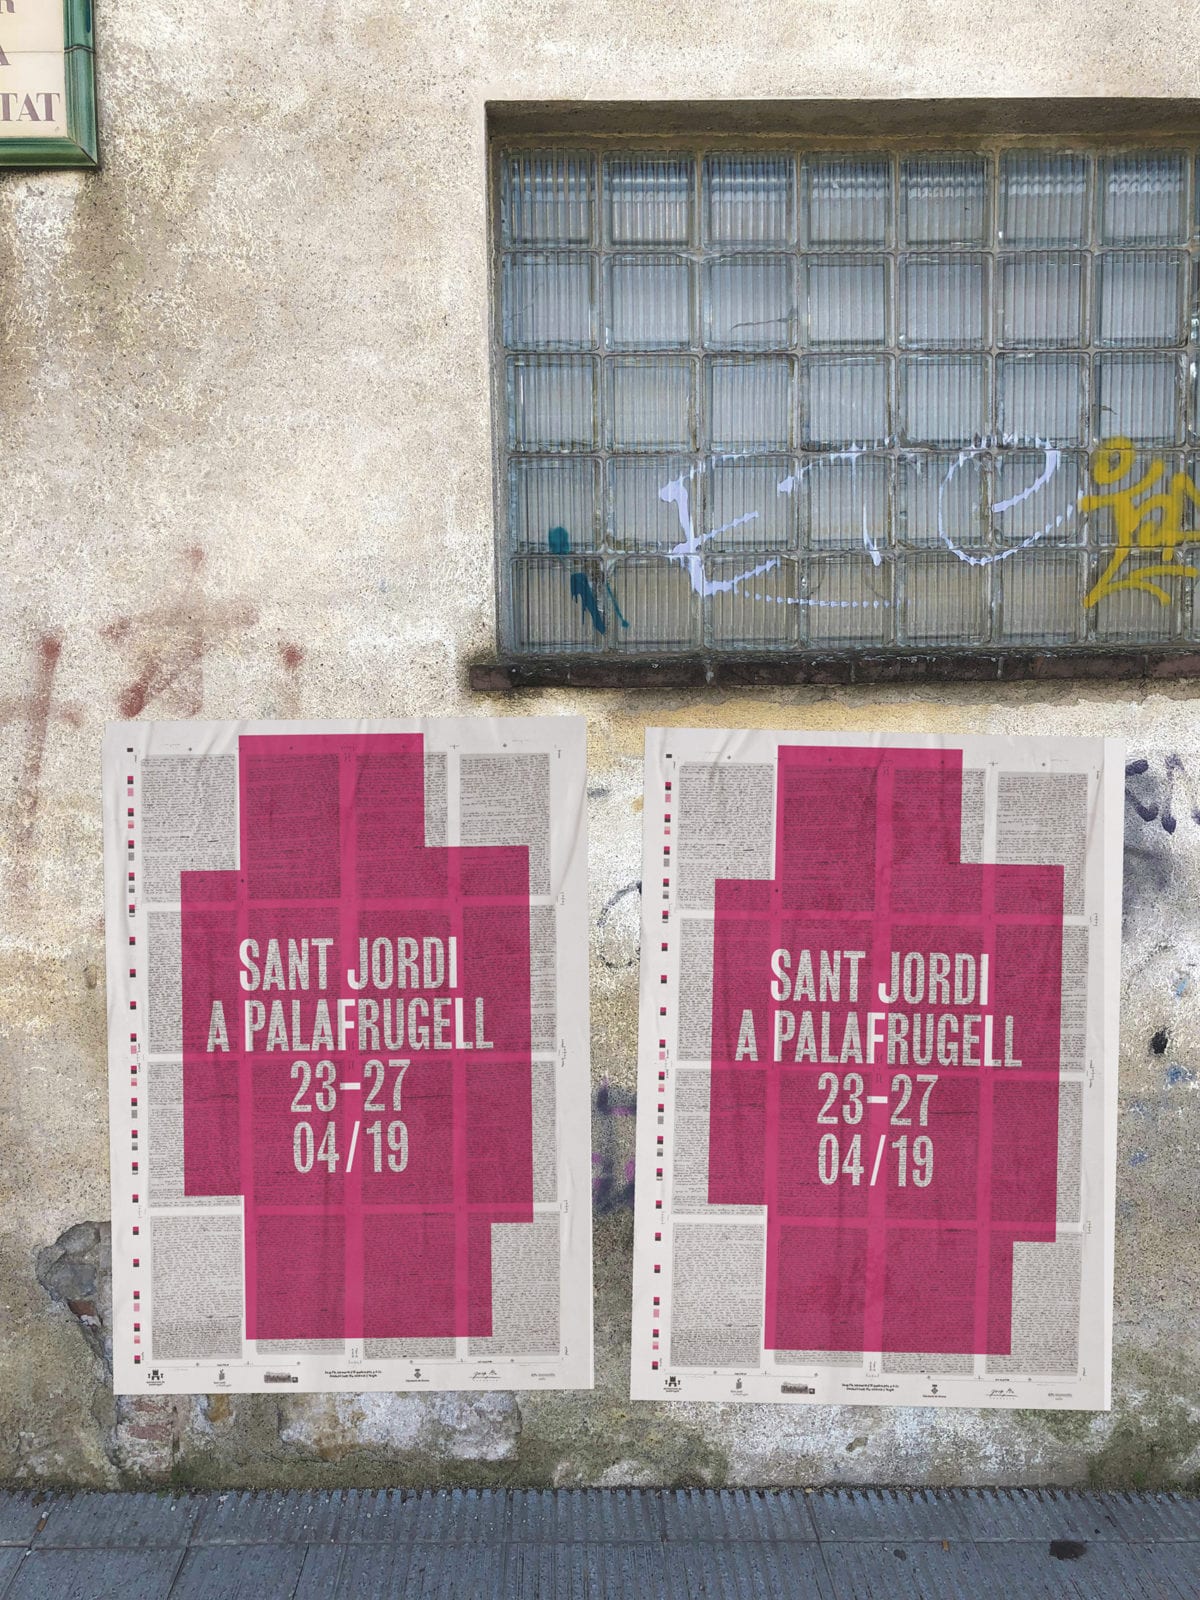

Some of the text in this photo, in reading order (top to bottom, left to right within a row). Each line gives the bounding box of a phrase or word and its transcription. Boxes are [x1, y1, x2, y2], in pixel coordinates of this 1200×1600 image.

[238, 936, 458, 991] SANT JORDI
[770, 948, 989, 1006] SANT JORDI
[206, 997, 494, 1053] A PALAFRUGELL
[734, 1009, 1023, 1068] A PALAFRUGELL
[290, 1058, 411, 1113] 23-27
[816, 1072, 939, 1127] 23-27
[292, 1120, 409, 1174] 04/19
[817, 1132, 935, 1188] 04/19
